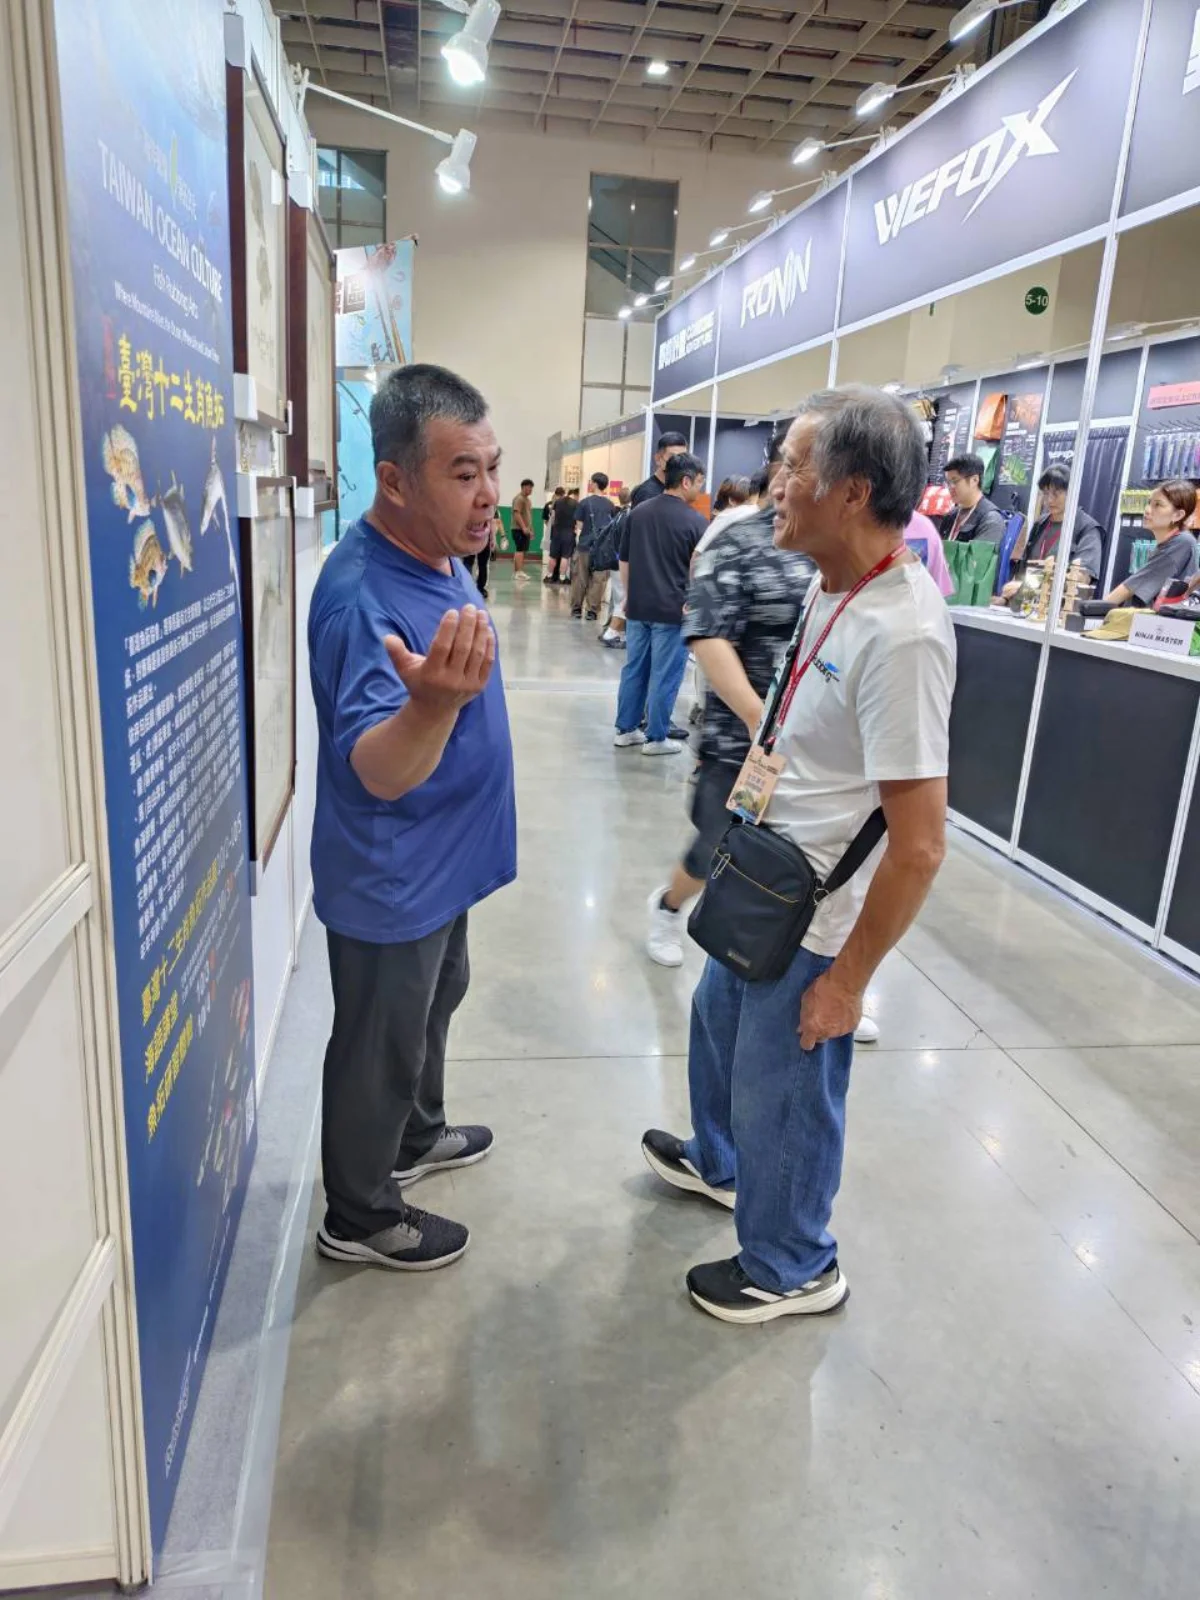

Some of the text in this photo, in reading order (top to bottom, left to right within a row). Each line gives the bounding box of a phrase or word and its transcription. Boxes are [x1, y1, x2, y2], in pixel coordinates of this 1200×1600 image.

[98, 139, 154, 235] TAIWAN
[156, 205, 190, 271] OCEAN
[190, 243, 222, 303] CULTURE
[874, 67, 1080, 246] WEFOX
[740, 236, 812, 328] RONIN
